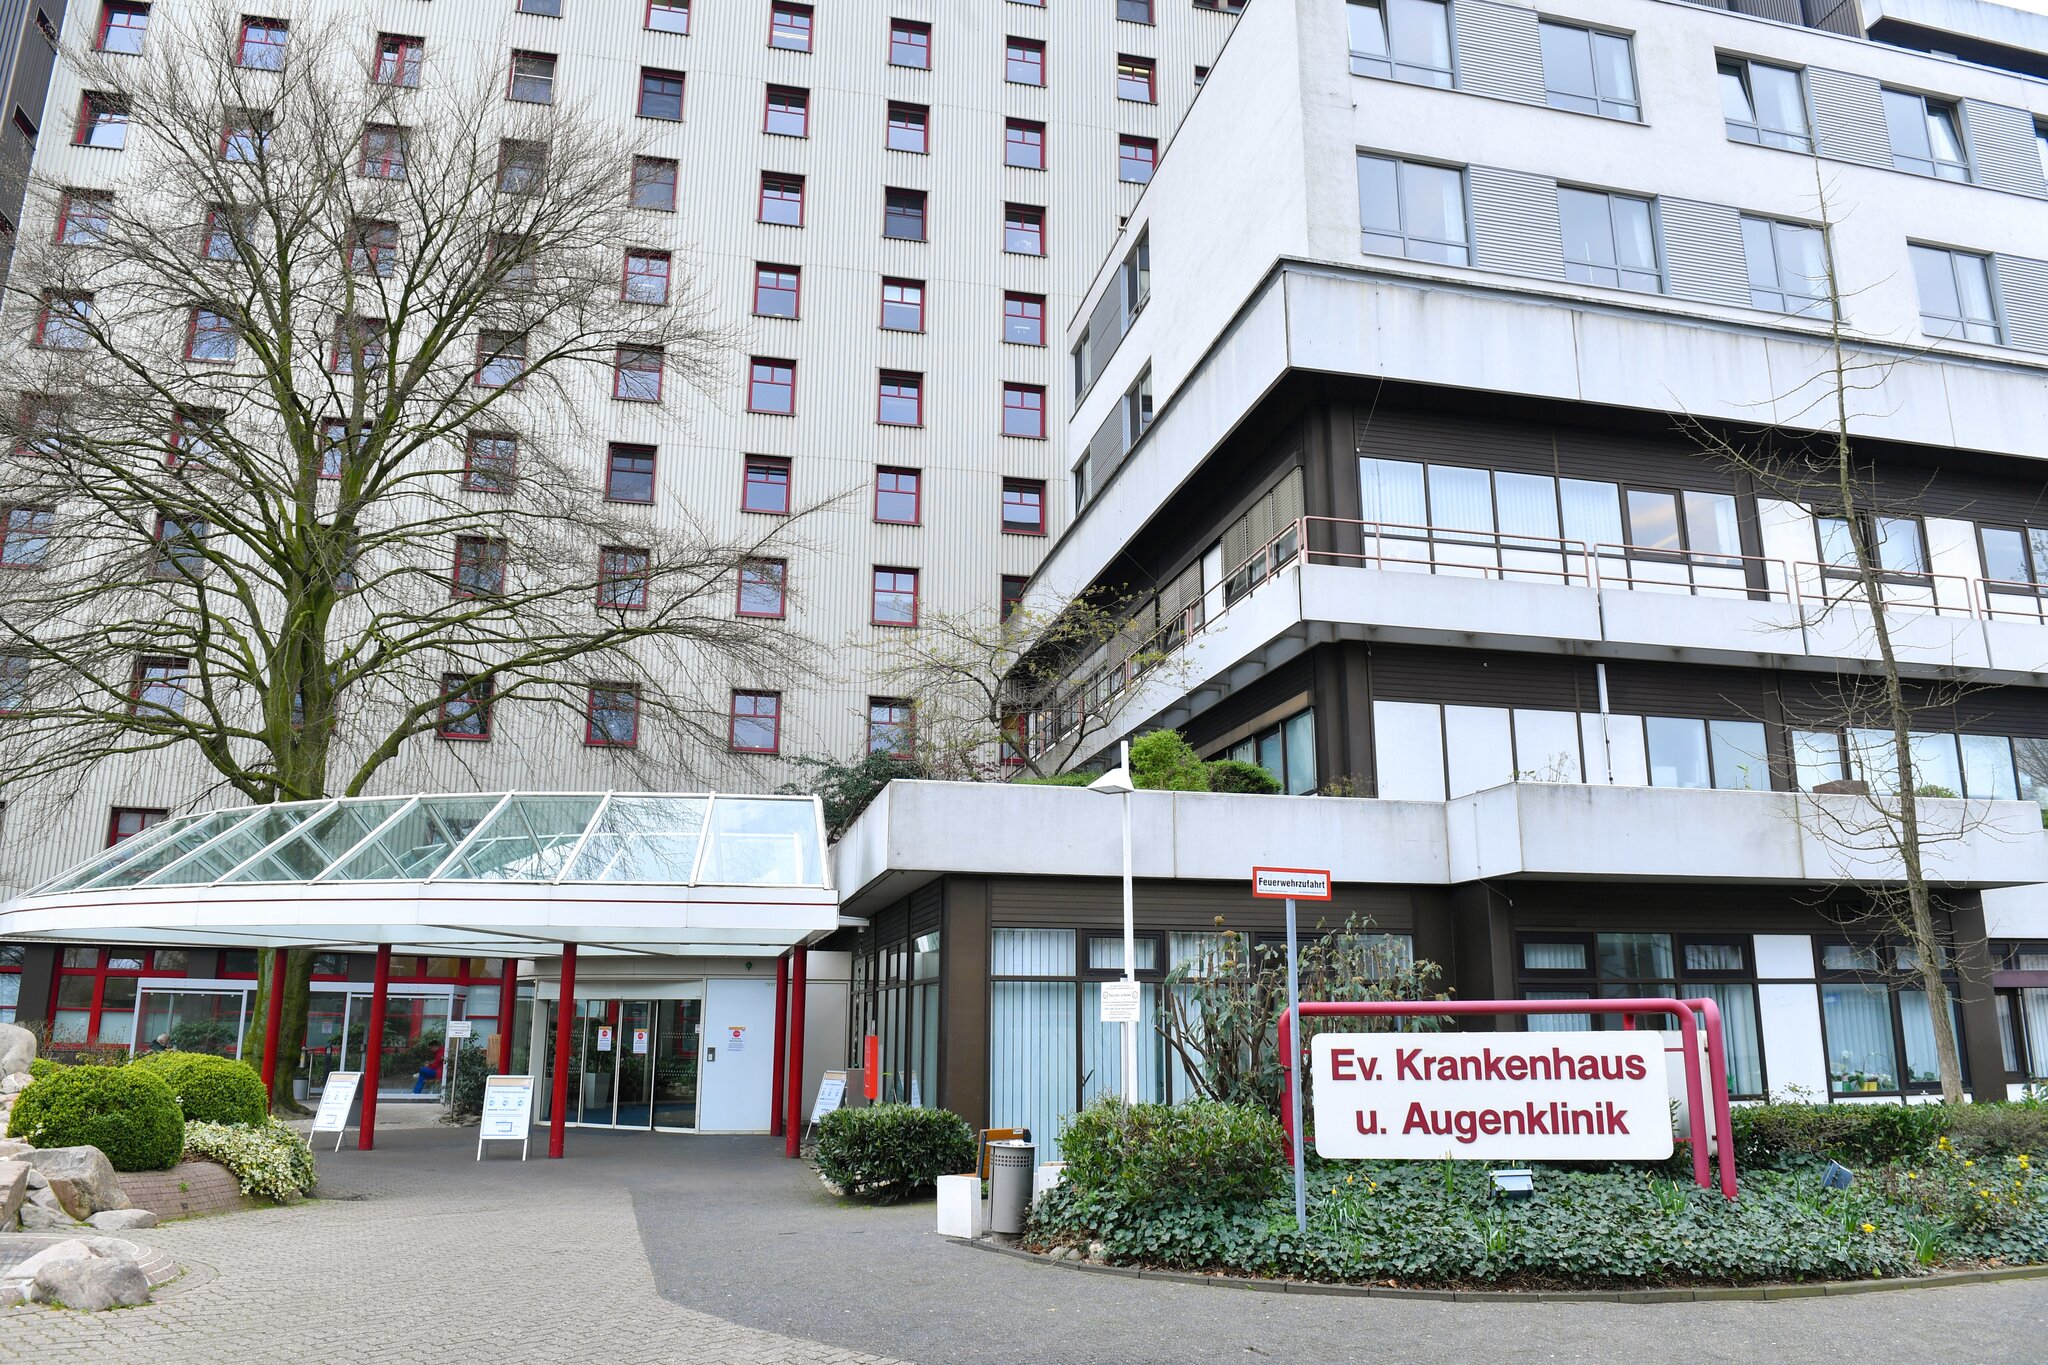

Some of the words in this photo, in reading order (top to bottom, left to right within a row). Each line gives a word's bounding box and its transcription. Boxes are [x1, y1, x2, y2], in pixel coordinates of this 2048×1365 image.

[1258, 877, 1325, 889] Feuerwehrzufahrt
[1331, 1048, 1383, 1081] Ev.
[1396, 1047, 1647, 1081] Krankenhaus
[1356, 1109, 1387, 1136] u.
[1402, 1101, 1630, 1144] Augenklinik
